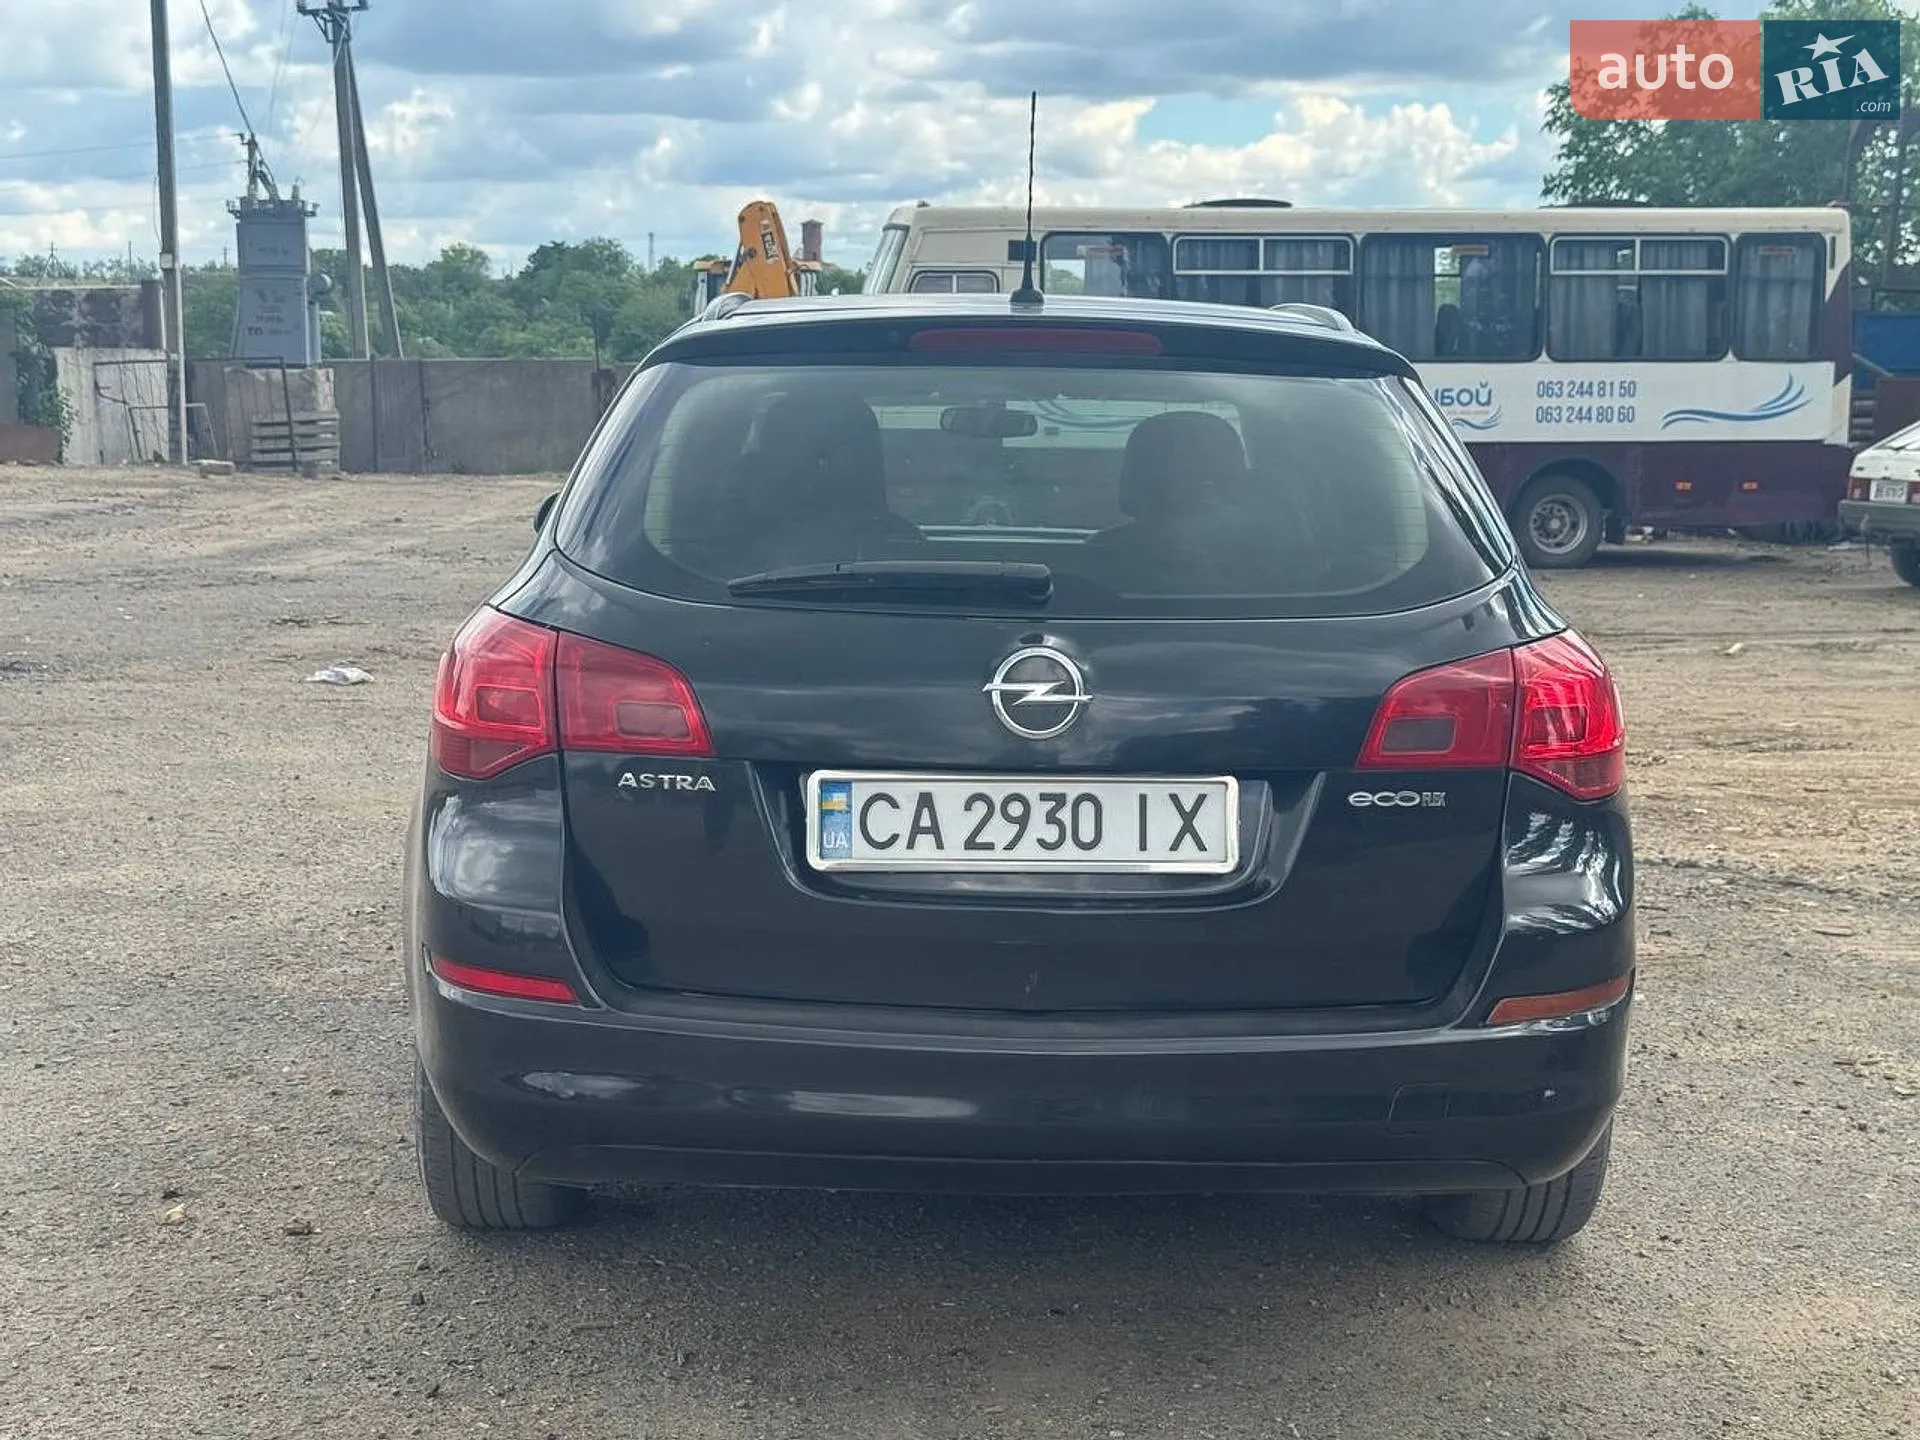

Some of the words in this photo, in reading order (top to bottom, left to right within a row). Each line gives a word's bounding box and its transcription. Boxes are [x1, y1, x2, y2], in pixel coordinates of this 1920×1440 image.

[1536, 380, 1563, 398] 063
[1567, 380, 1593, 398] 244
[1597, 380, 1614, 398] 81
[1619, 380, 1637, 398] 50
[1535, 406, 1563, 424] 063
[1566, 406, 1593, 424] 244
[1596, 406, 1614, 424] 80
[1617, 406, 1636, 424] 60
[617, 772, 716, 792] ASTRA
[859, 791, 945, 851] CA
[963, 792, 1103, 852] 2930
[1138, 793, 1208, 852] IX
[823, 831, 848, 849] UA
